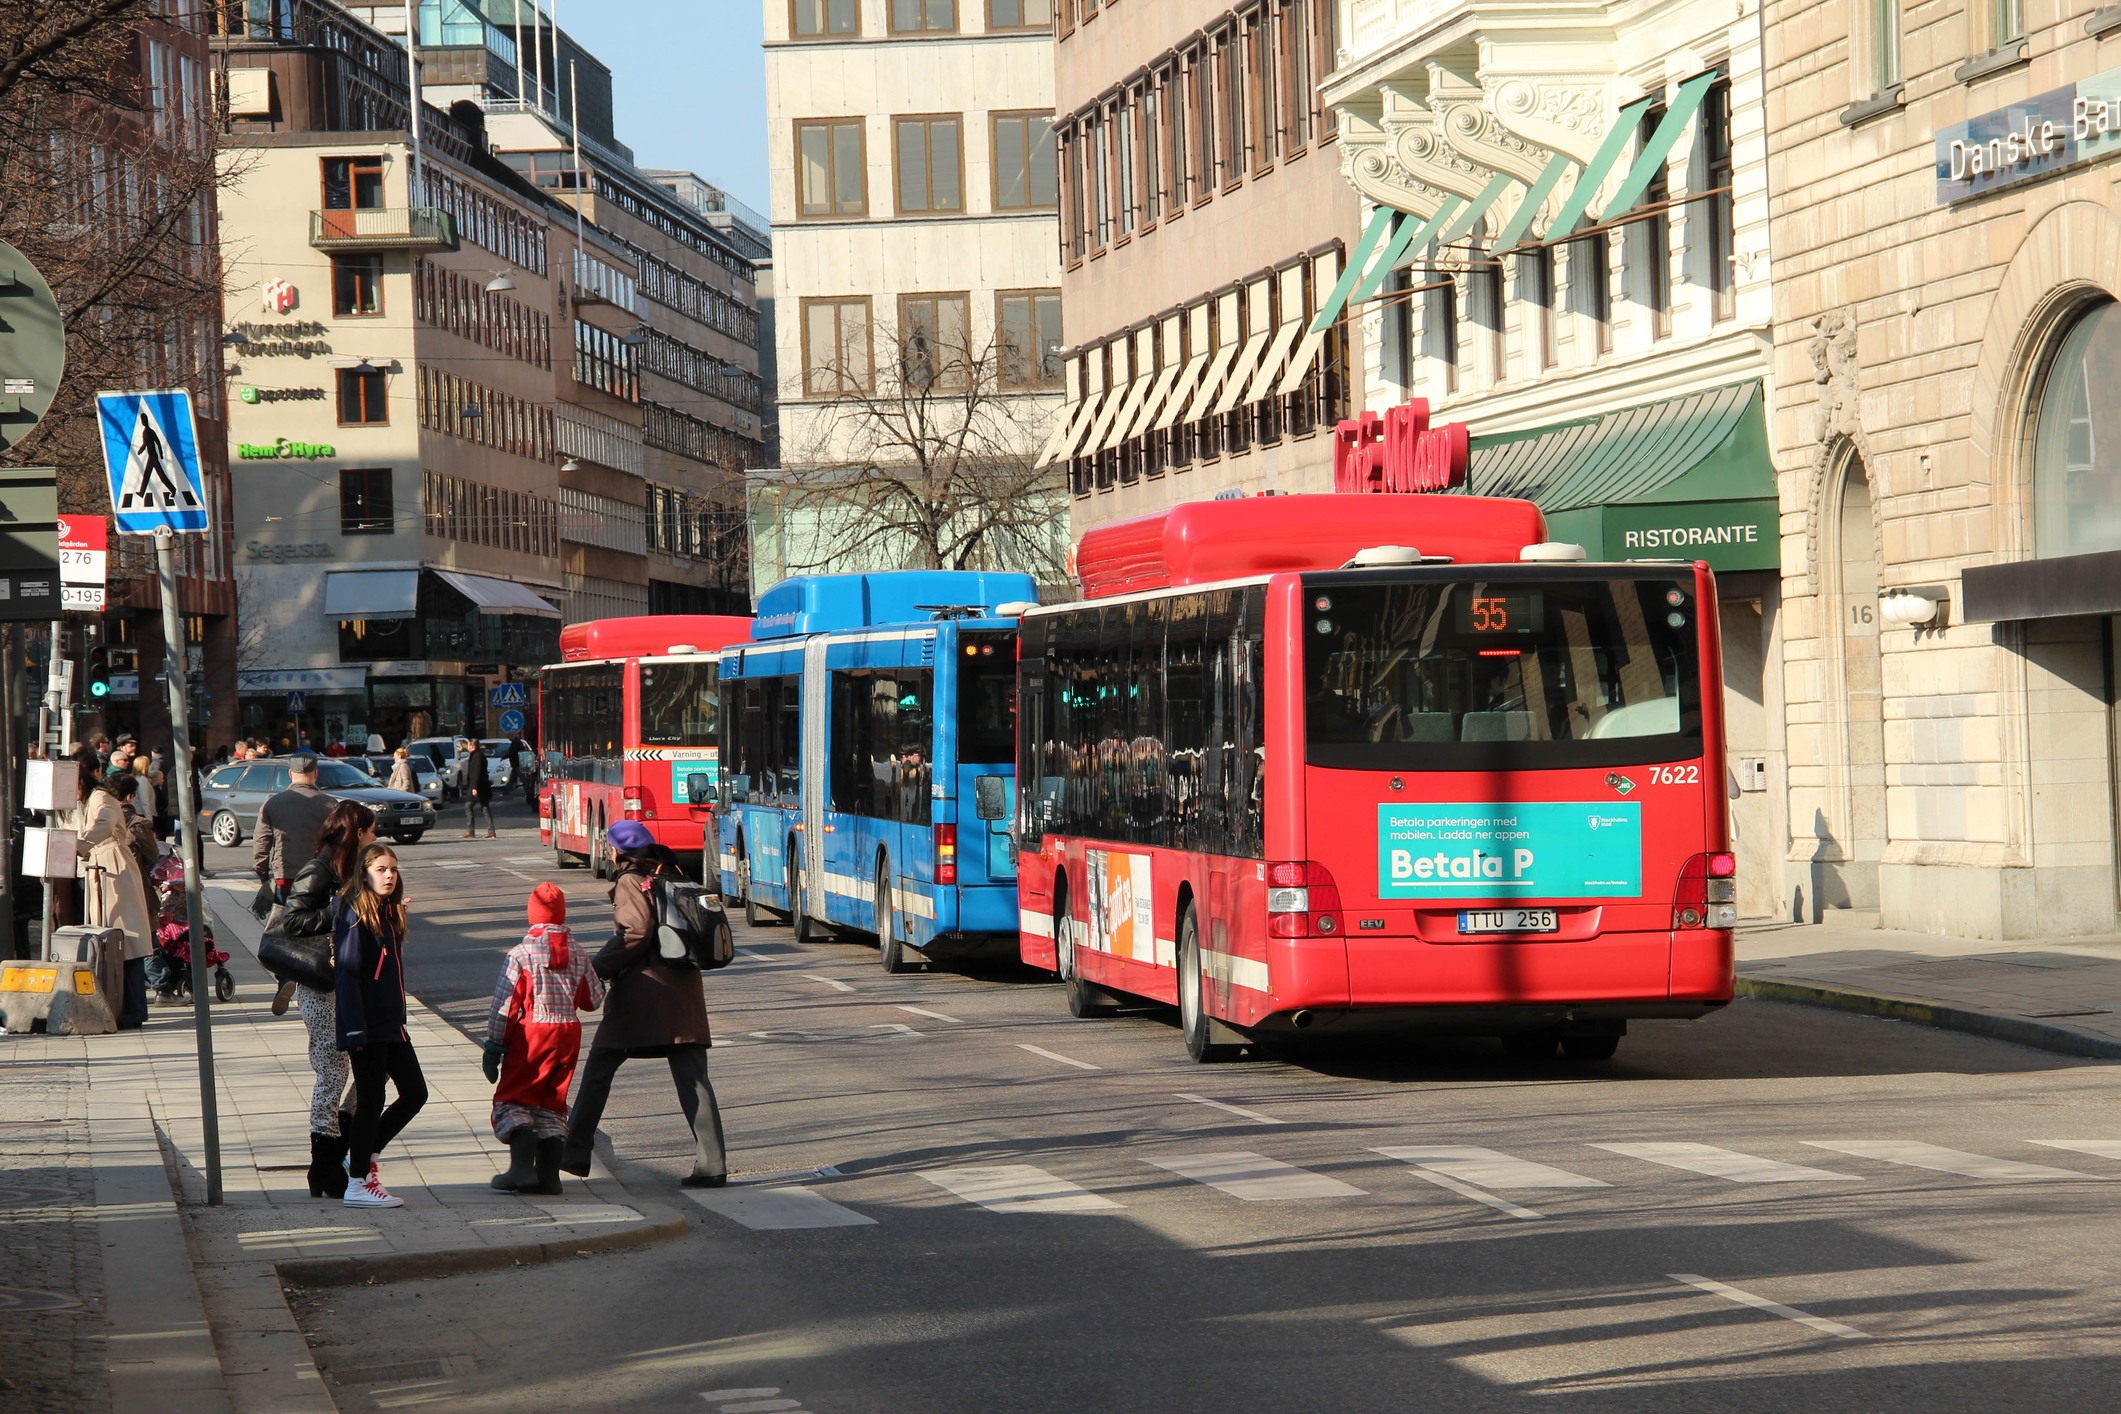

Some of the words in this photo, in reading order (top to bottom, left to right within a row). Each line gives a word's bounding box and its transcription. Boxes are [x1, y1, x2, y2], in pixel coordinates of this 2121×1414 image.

[1950, 114, 2055, 182] Danske
[1625, 524, 1758, 548] RISTORANTE
[75, 552, 92, 565] 76
[1473, 597, 1507, 631] 55
[1851, 604, 1873, 625] 16
[672, 751, 702, 762] Varning
[1649, 765, 1699, 785] 7622
[1390, 816, 1424, 827] Betala
[1427, 816, 1490, 829] parkeringen
[1493, 816, 1517, 827] med
[1390, 830, 1435, 840] mobilen.
[1438, 829, 1472, 840] Ladda
[1475, 831, 1492, 840] ner
[1495, 831, 1529, 841] appen
[1391, 848, 1503, 879] Betala
[1514, 848, 1534, 878] P
[1360, 920, 1383, 928] EEV
[1469, 912, 1504, 929] TTU
[1517, 911, 1551, 928] 256
